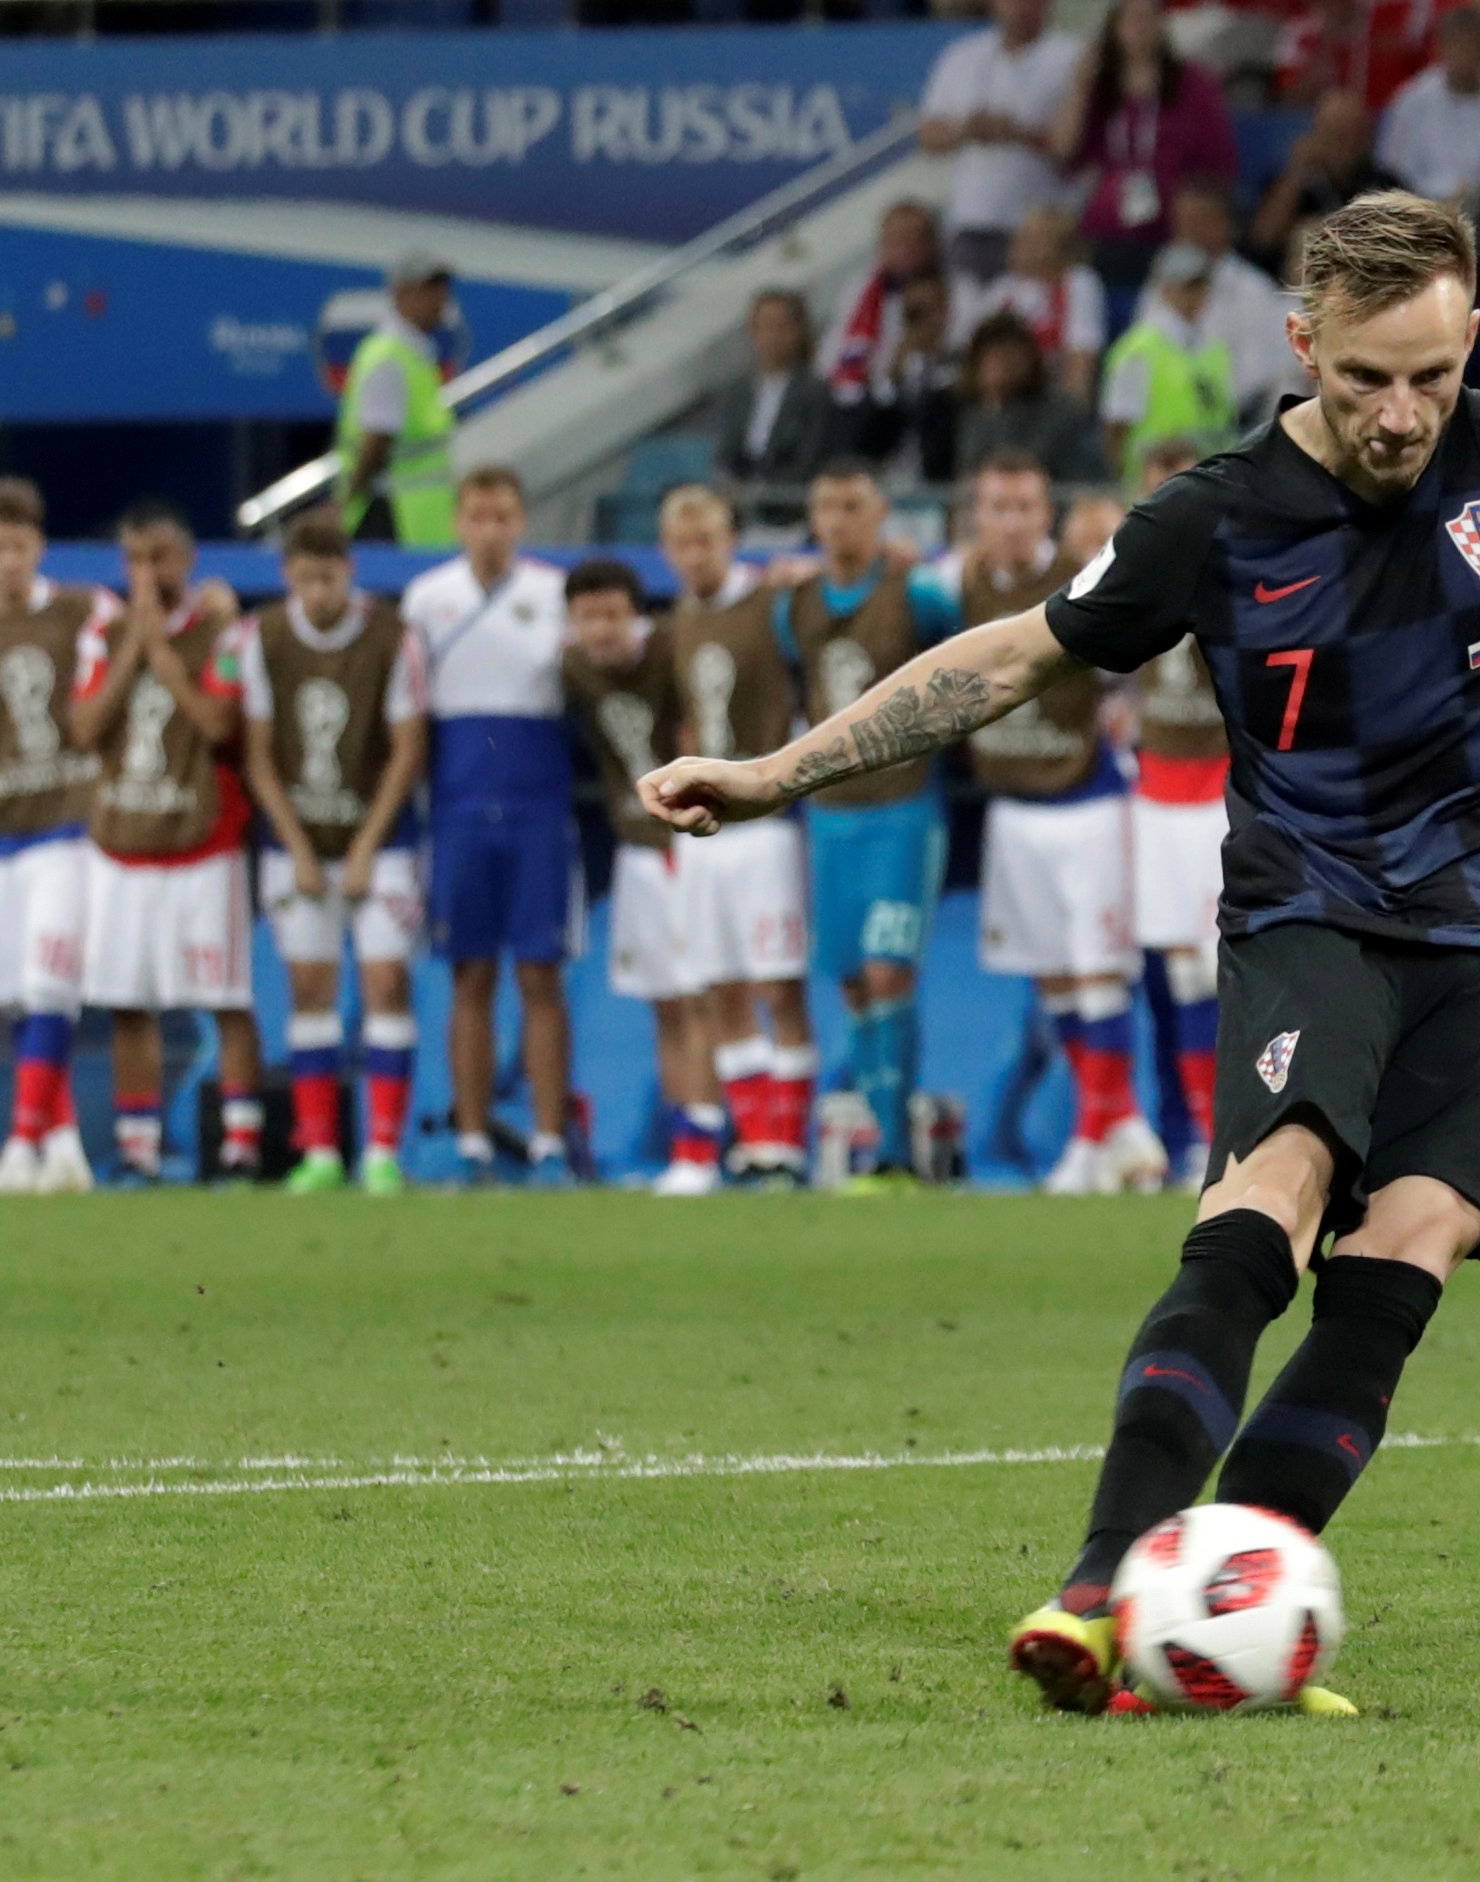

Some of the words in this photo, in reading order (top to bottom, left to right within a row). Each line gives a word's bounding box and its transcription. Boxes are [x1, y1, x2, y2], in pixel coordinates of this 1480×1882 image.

[0, 92, 116, 172] IFA
[124, 87, 394, 170] WORLD
[402, 84, 560, 167] CUP
[570, 81, 855, 164] RUSSIA
[1265, 648, 1315, 751] 7
